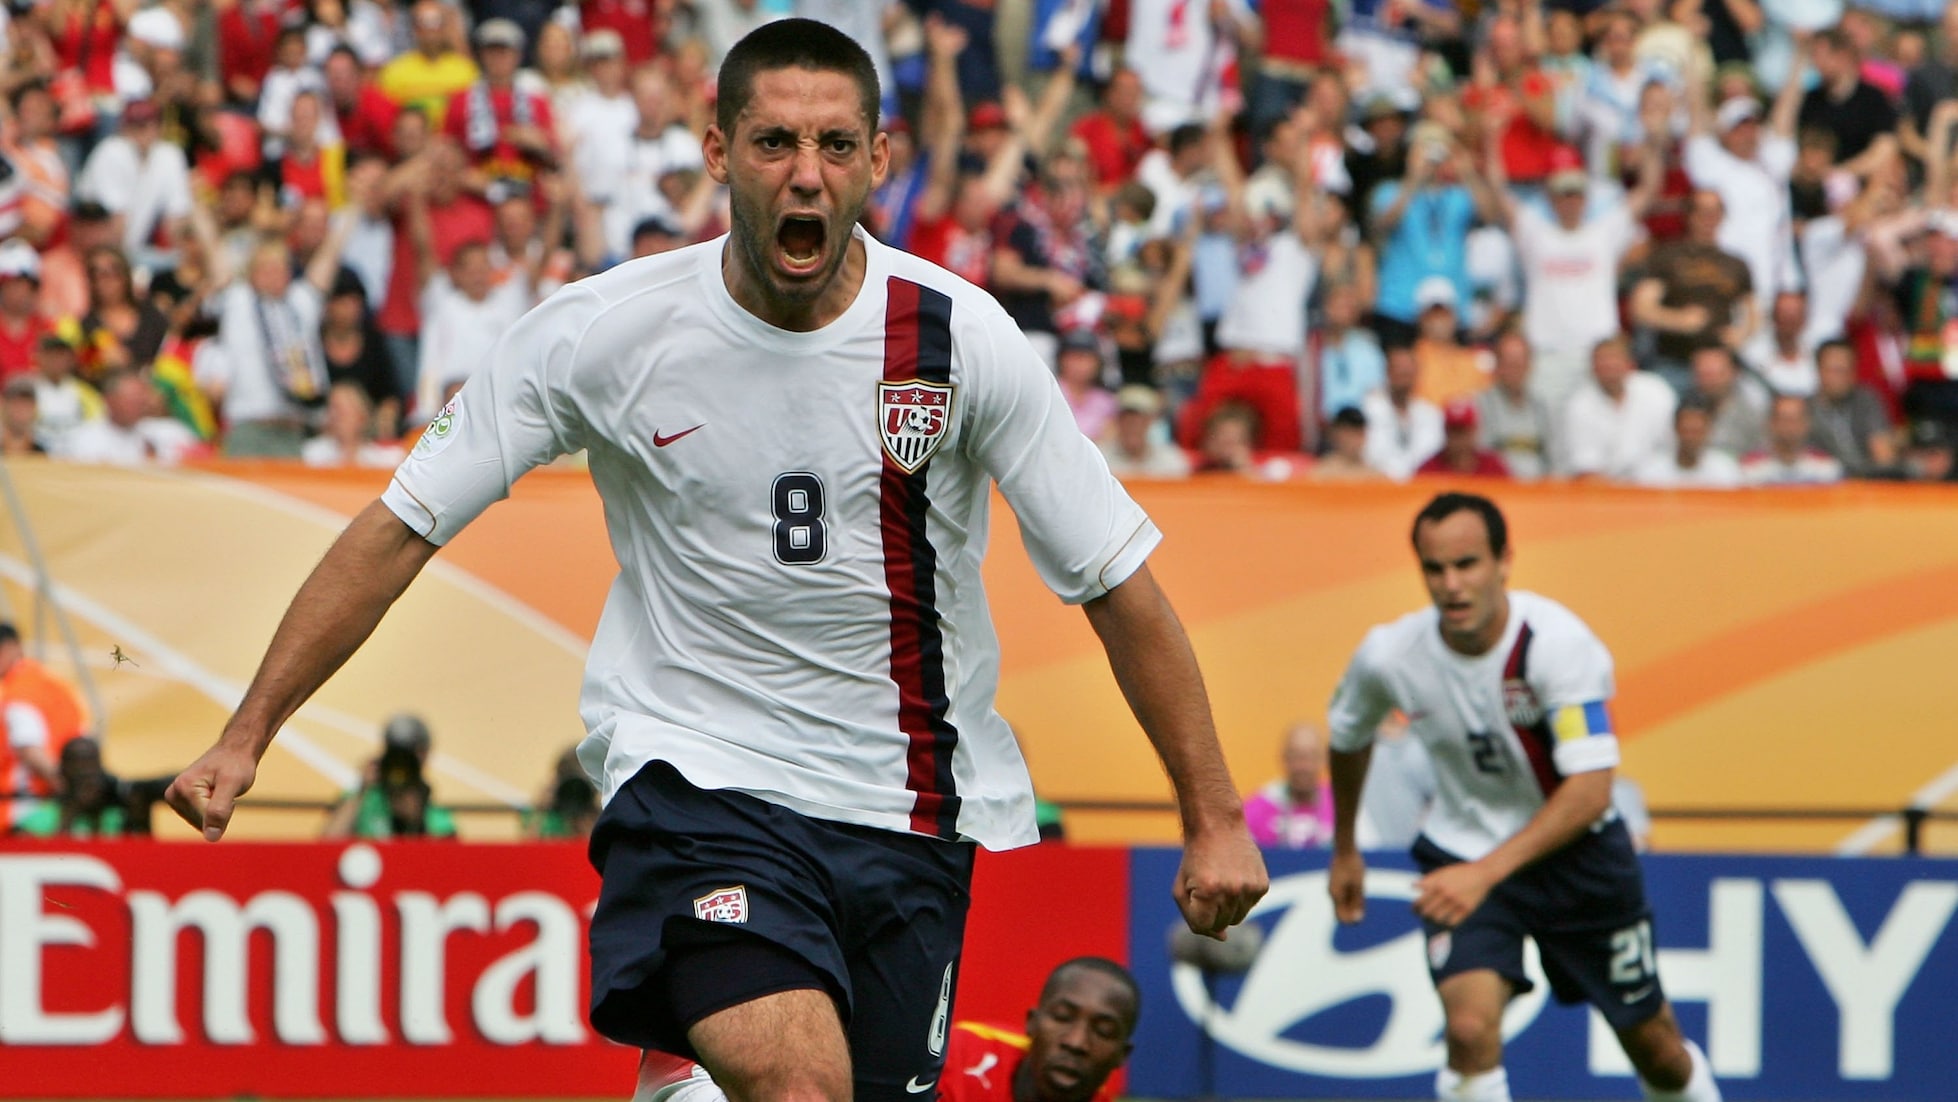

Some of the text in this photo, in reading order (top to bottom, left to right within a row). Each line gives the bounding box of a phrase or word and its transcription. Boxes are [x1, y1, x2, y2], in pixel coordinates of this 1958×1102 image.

[887, 407, 943, 435] US
[770, 472, 827, 565] 8
[0, 844, 599, 1045] Emira
[1588, 877, 1958, 1080] HY
[1610, 920, 1655, 982] 21
